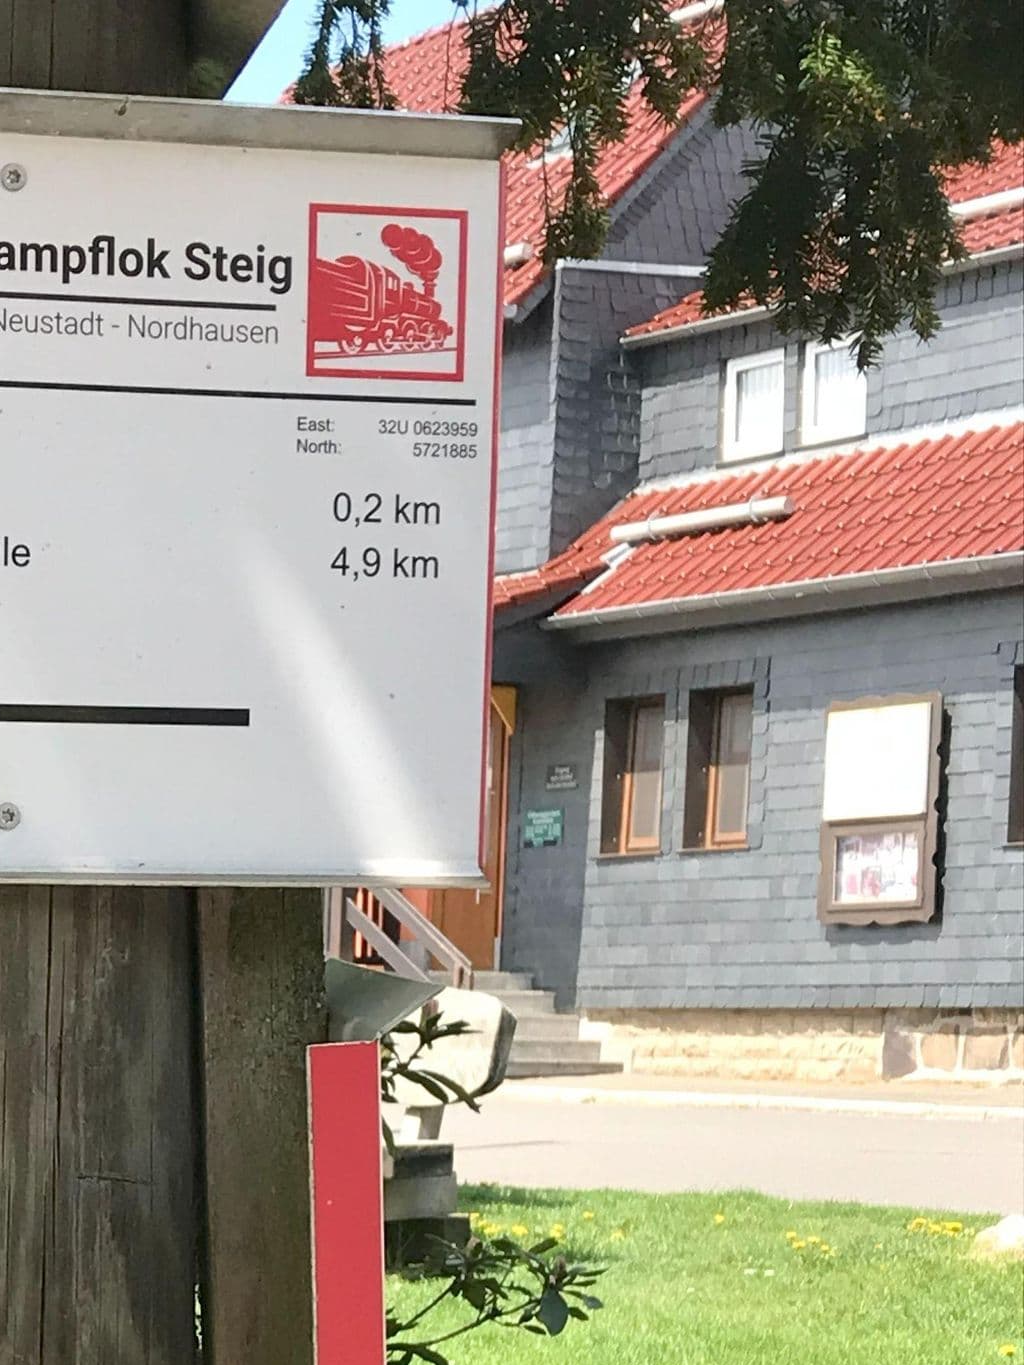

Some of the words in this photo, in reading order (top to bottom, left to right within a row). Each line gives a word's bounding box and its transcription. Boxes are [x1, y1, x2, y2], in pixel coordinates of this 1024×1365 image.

[183, 242, 293, 295] Steig
[128, 315, 279, 345] Nordhausen
[297, 416, 335, 432] East:
[378, 419, 409, 435] 32U
[413, 420, 478, 437] 0623959
[296, 438, 342, 455] North:
[413, 442, 478, 459] 5721885
[333, 491, 382, 528] 0,2
[394, 493, 441, 525] km
[330, 546, 381, 582] 4,9
[393, 547, 439, 579] km
